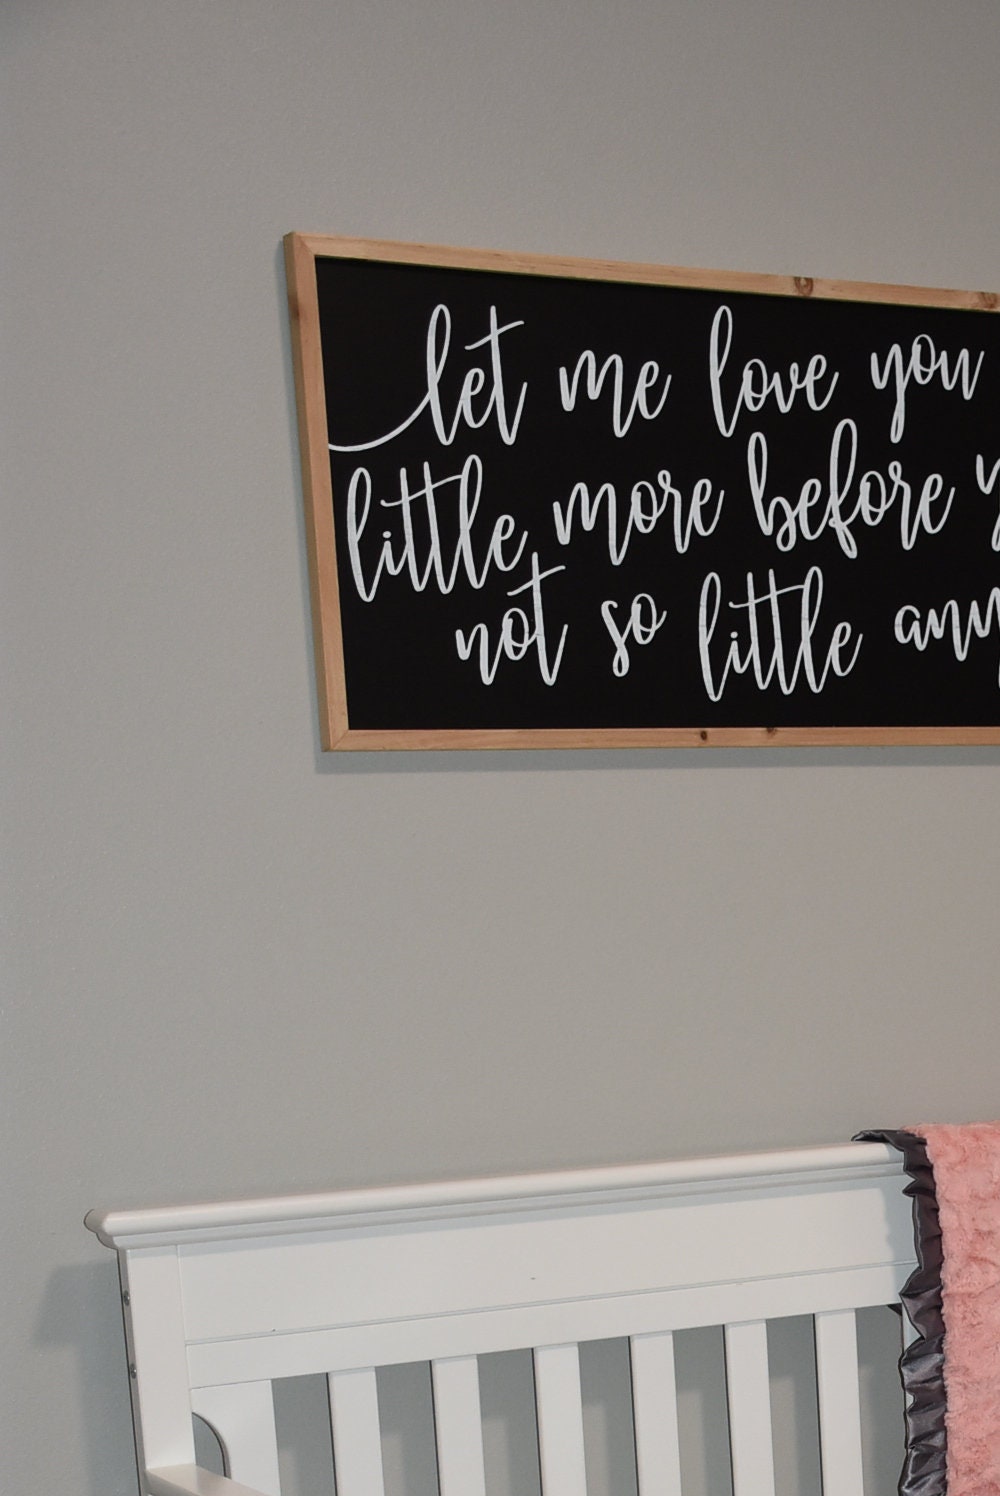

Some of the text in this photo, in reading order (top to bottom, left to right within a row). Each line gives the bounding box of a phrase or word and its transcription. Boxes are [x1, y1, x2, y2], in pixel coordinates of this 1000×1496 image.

[329, 303, 528, 452] let
[559, 349, 672, 438] me
[709, 305, 840, 438] love
[870, 334, 985, 444] you
[346, 454, 529, 603] little
[552, 469, 725, 566] more
[747, 418, 956, 559] before
[455, 551, 569, 686] not
[600, 593, 667, 678] so
[698, 565, 863, 702] little
